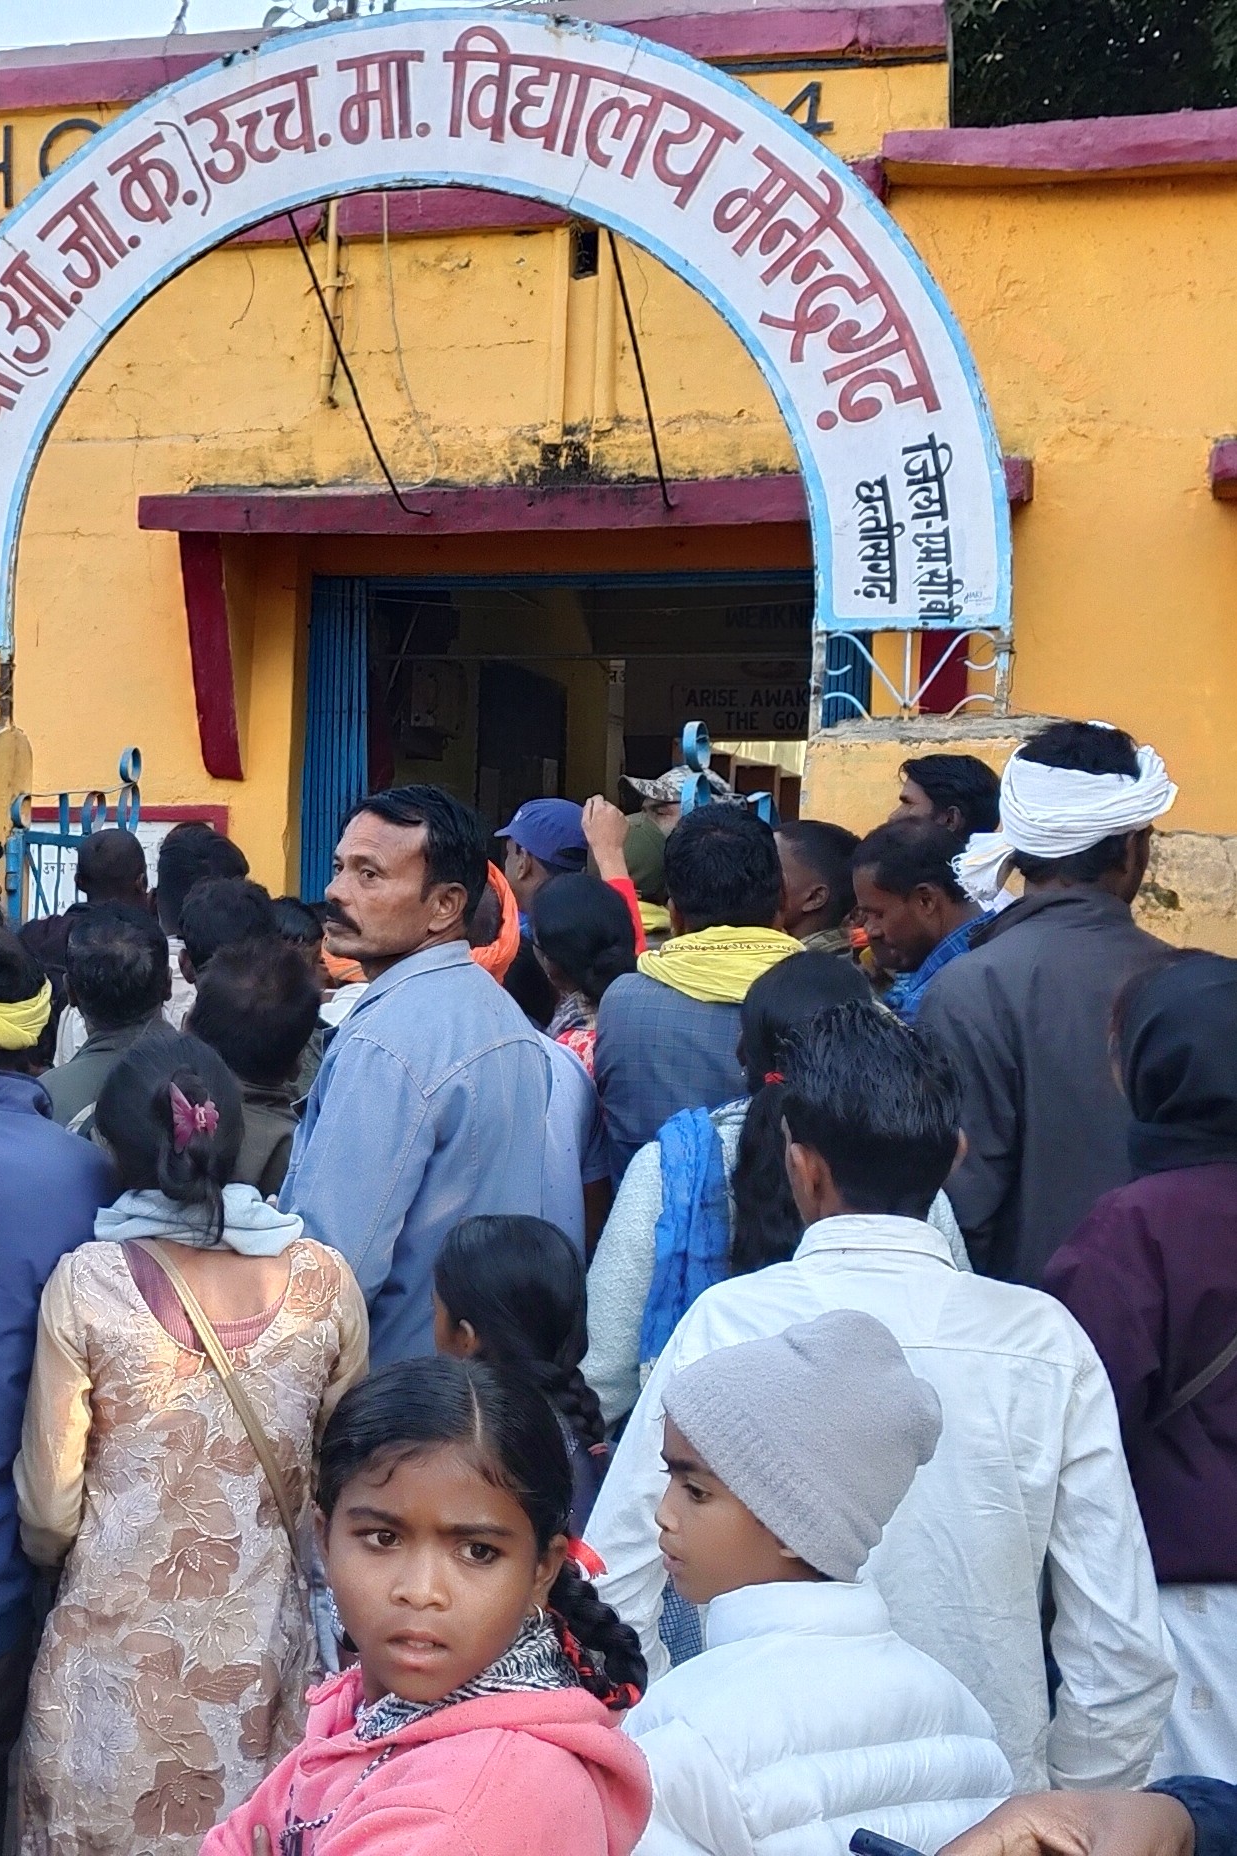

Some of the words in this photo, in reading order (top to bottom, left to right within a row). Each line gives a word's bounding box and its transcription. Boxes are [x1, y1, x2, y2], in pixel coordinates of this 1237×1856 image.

[443, 25, 745, 211] विद्यालय
[725, 604, 810, 629] WEAKN
[724, 711, 760, 731] THE
